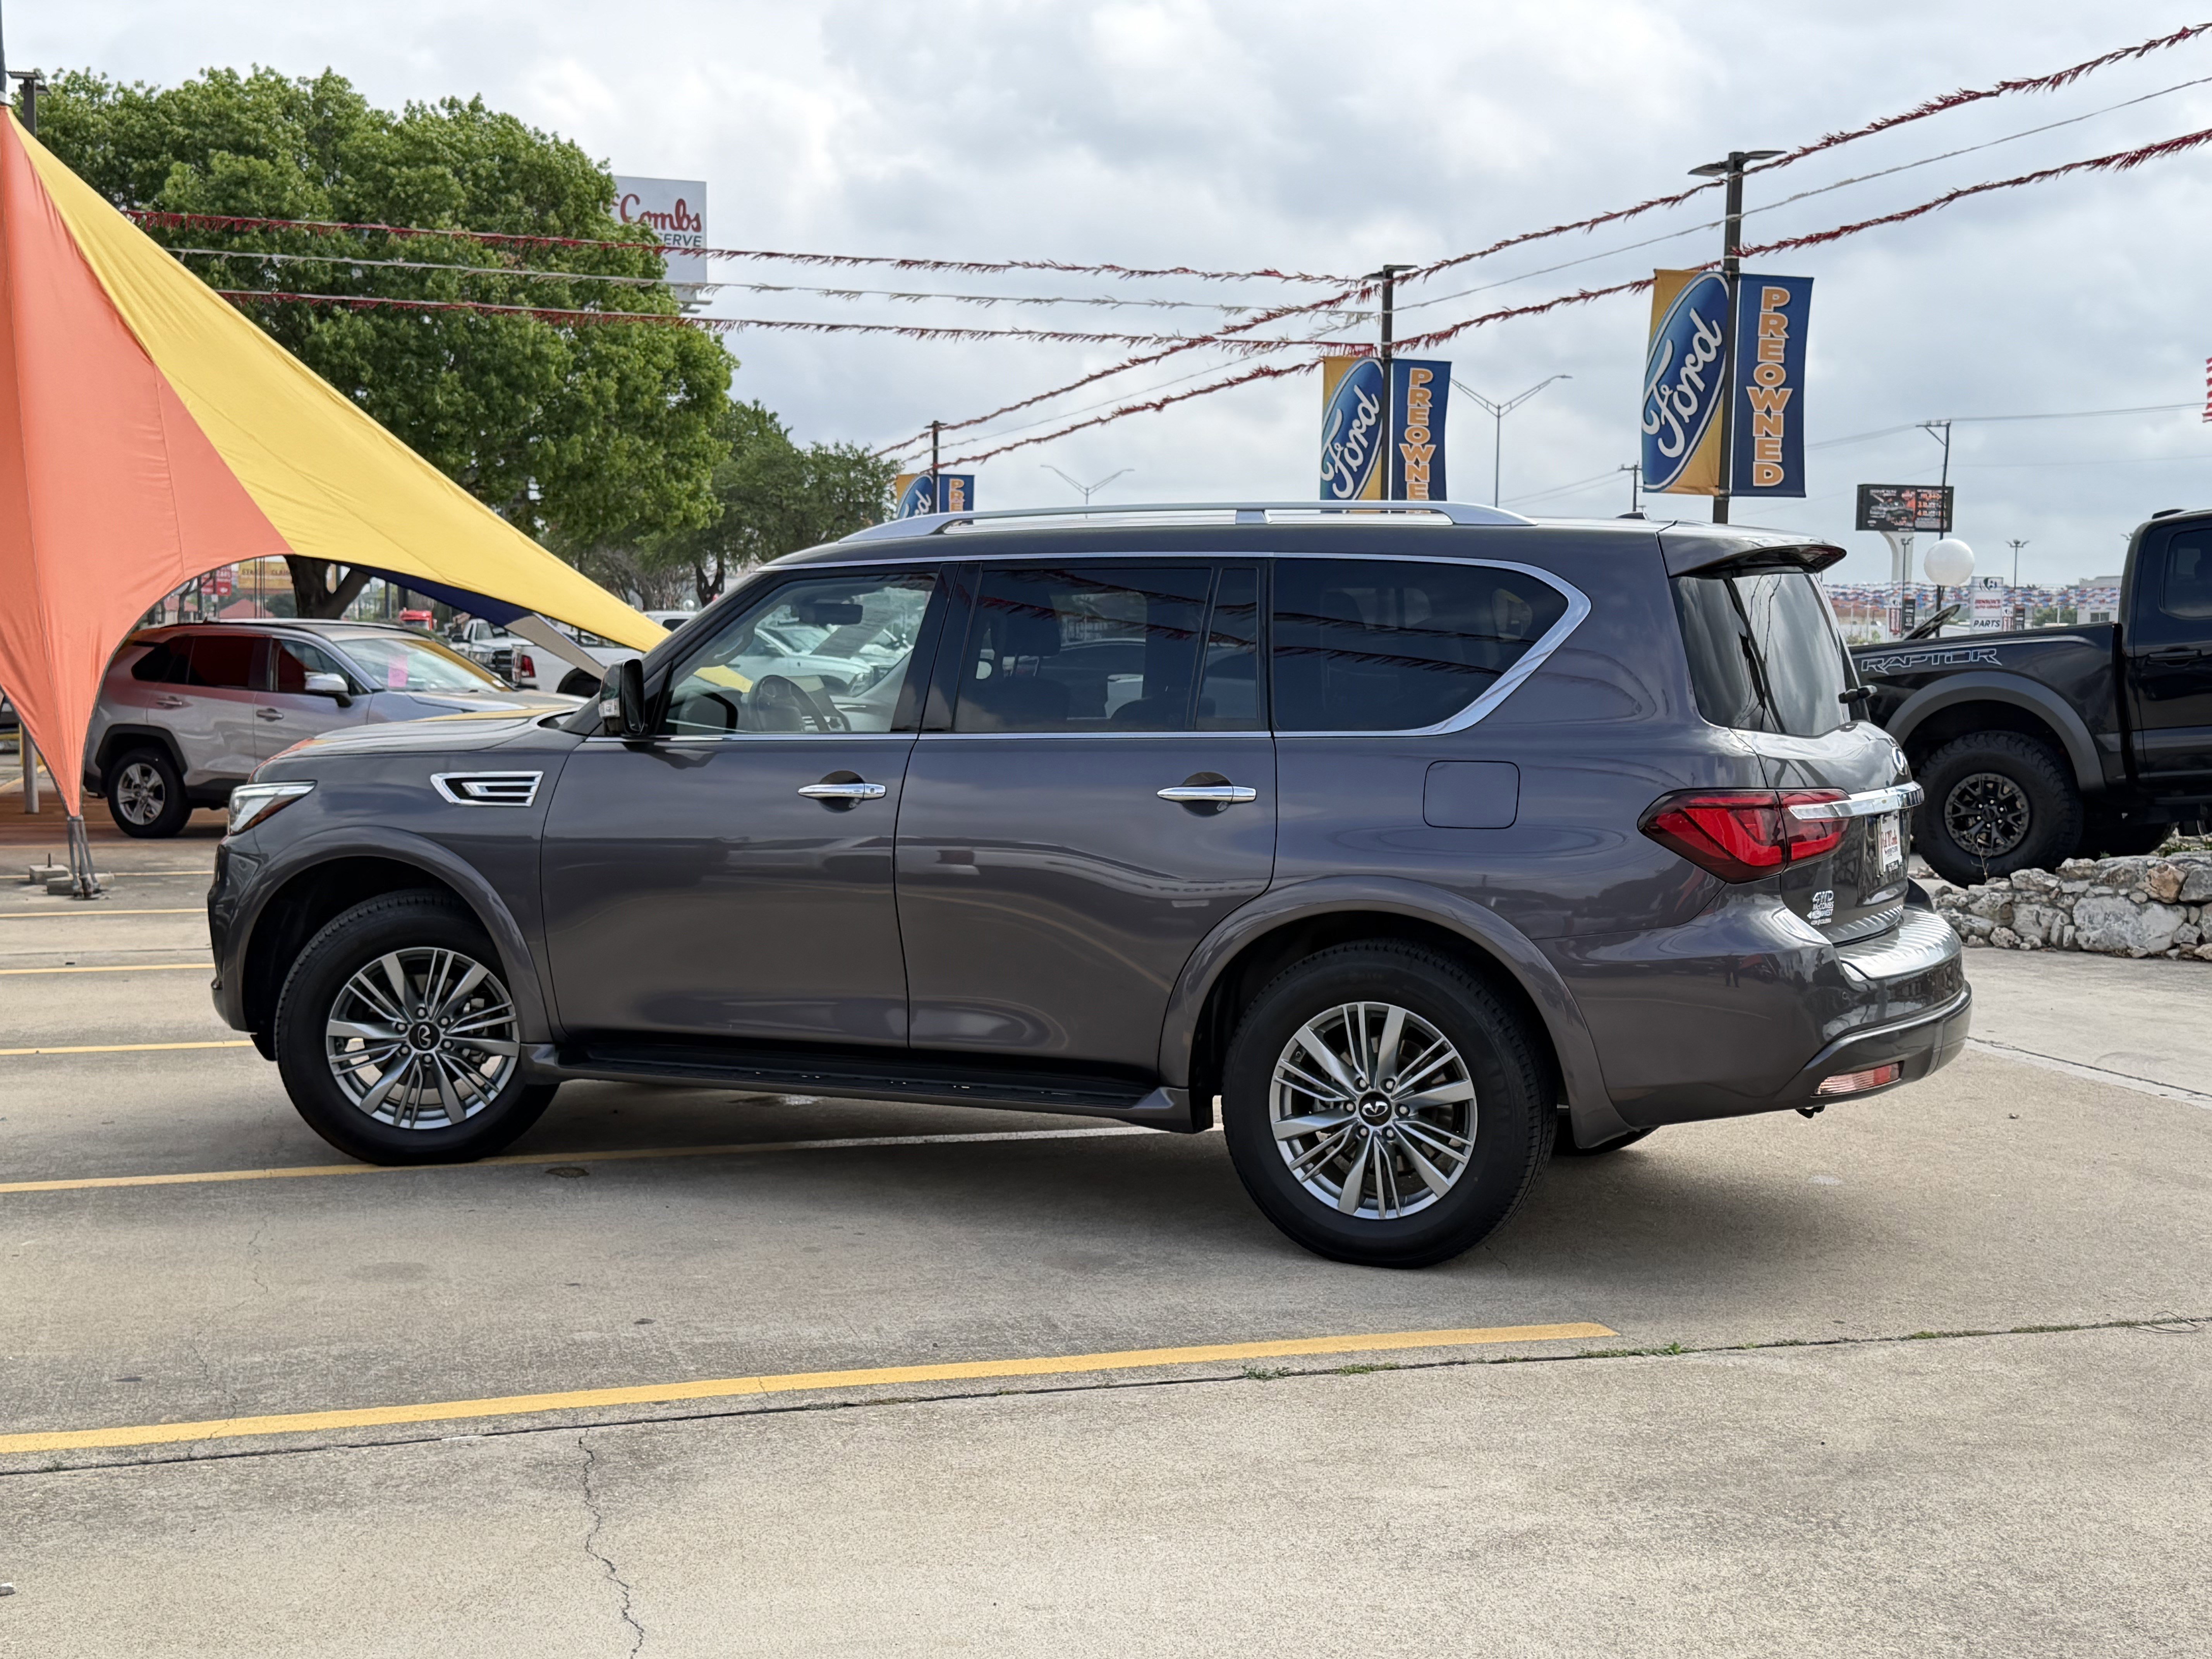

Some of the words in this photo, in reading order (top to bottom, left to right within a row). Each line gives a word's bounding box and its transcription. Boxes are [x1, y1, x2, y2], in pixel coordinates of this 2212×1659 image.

[612, 194, 702, 232] Combs
[1321, 384, 1380, 498] Ford
[1399, 367, 1437, 500] PREOWNE
[1642, 307, 1723, 458] Ford
[1746, 286, 1793, 487] PREOWNED
[1861, 648, 2003, 675] RAPTOR
